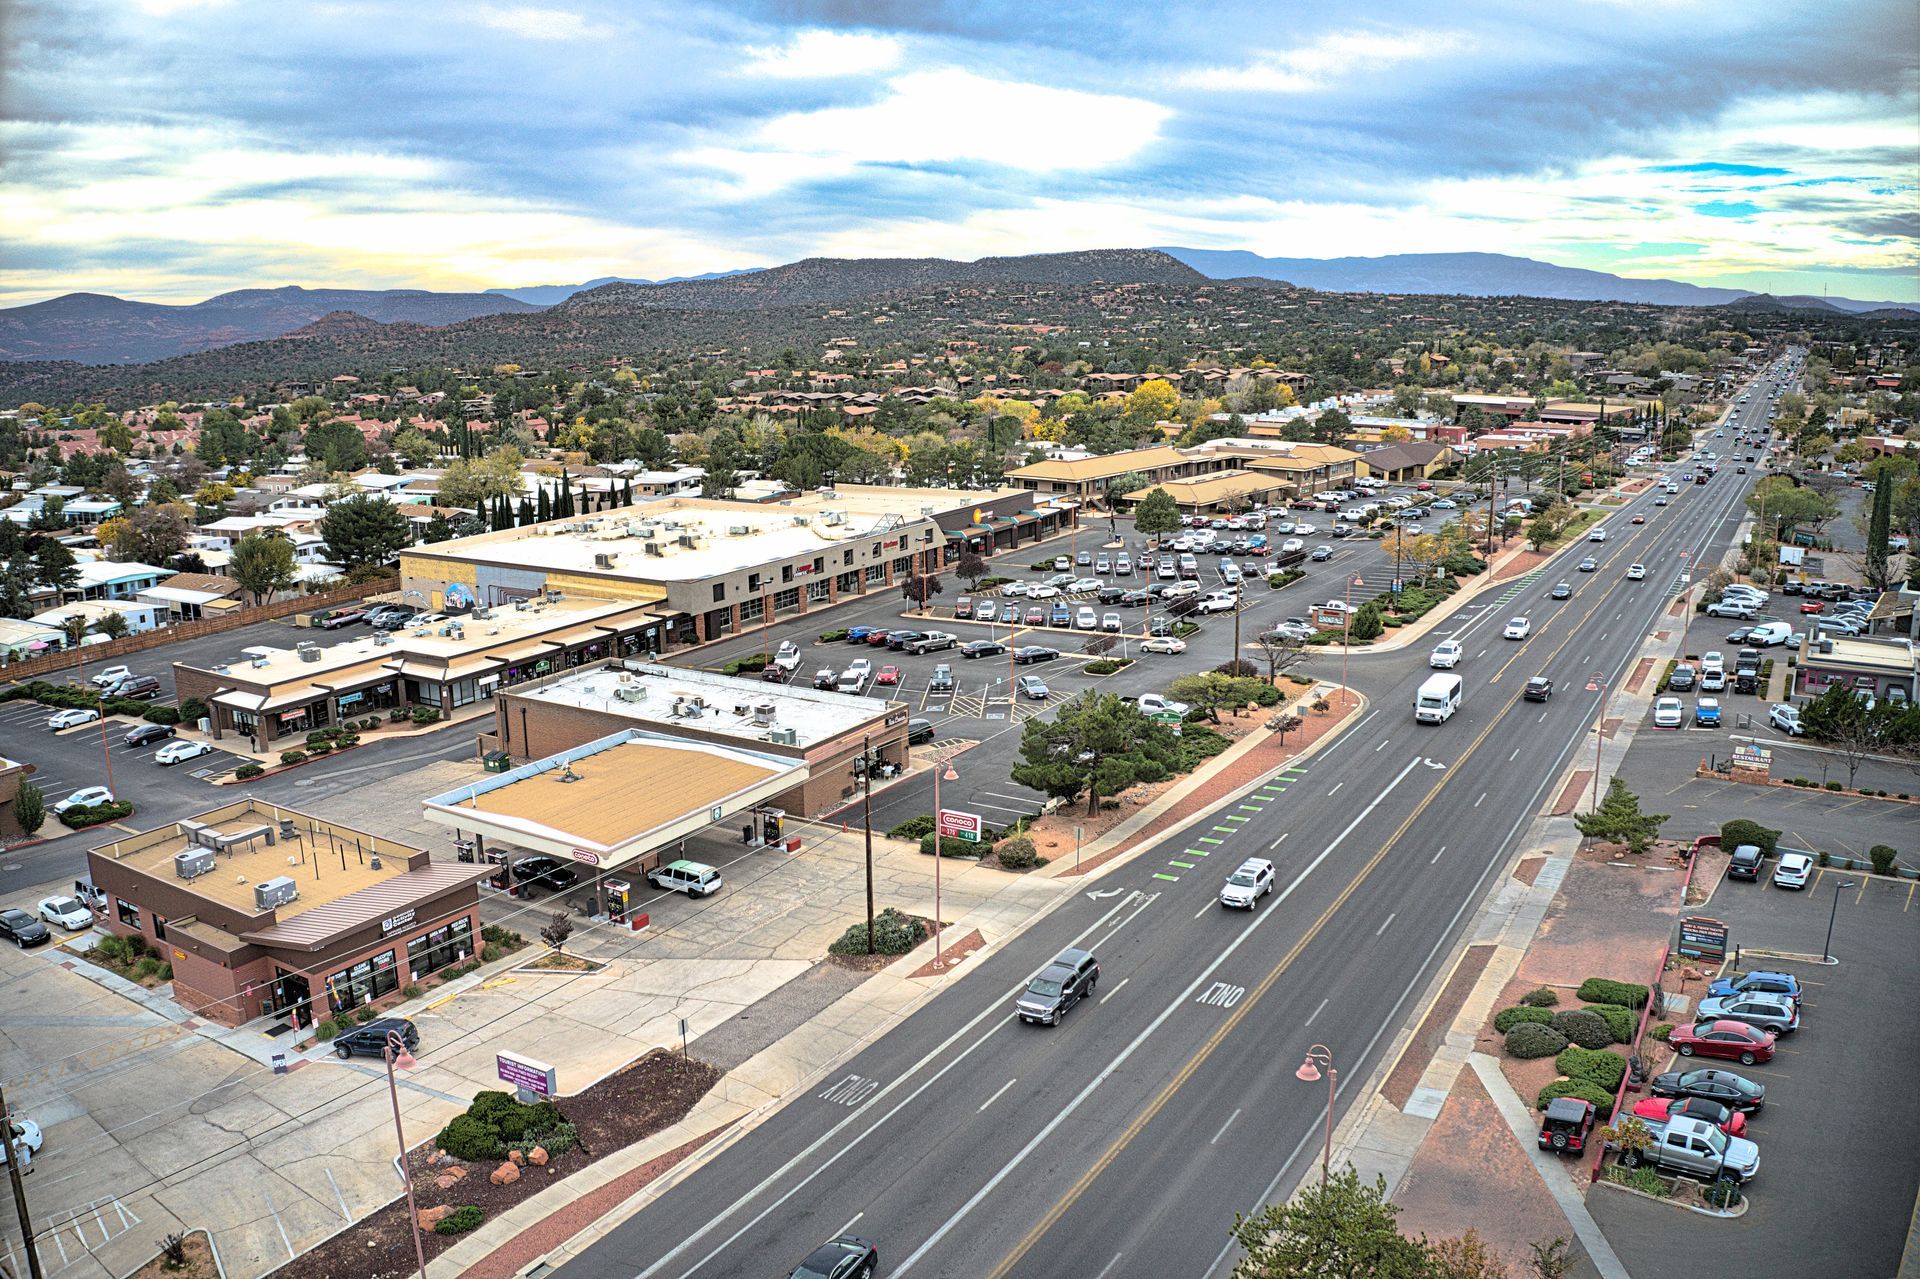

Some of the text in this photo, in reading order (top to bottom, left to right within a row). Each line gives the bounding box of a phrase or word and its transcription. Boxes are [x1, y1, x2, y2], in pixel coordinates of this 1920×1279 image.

[1732, 754, 1772, 764] RESTAURANT
[945, 816, 972, 827] conoco
[392, 911, 416, 924] Activity
[392, 916, 414, 927] Center
[353, 962, 367, 972] CLEAN
[1196, 981, 1246, 1008] ONLY
[273, 1058, 287, 1068] OPEN
[499, 1057, 517, 1067] TOURIST
[517, 1064, 546, 1077] INFORMATION
[818, 1073, 880, 1107] ONLY
